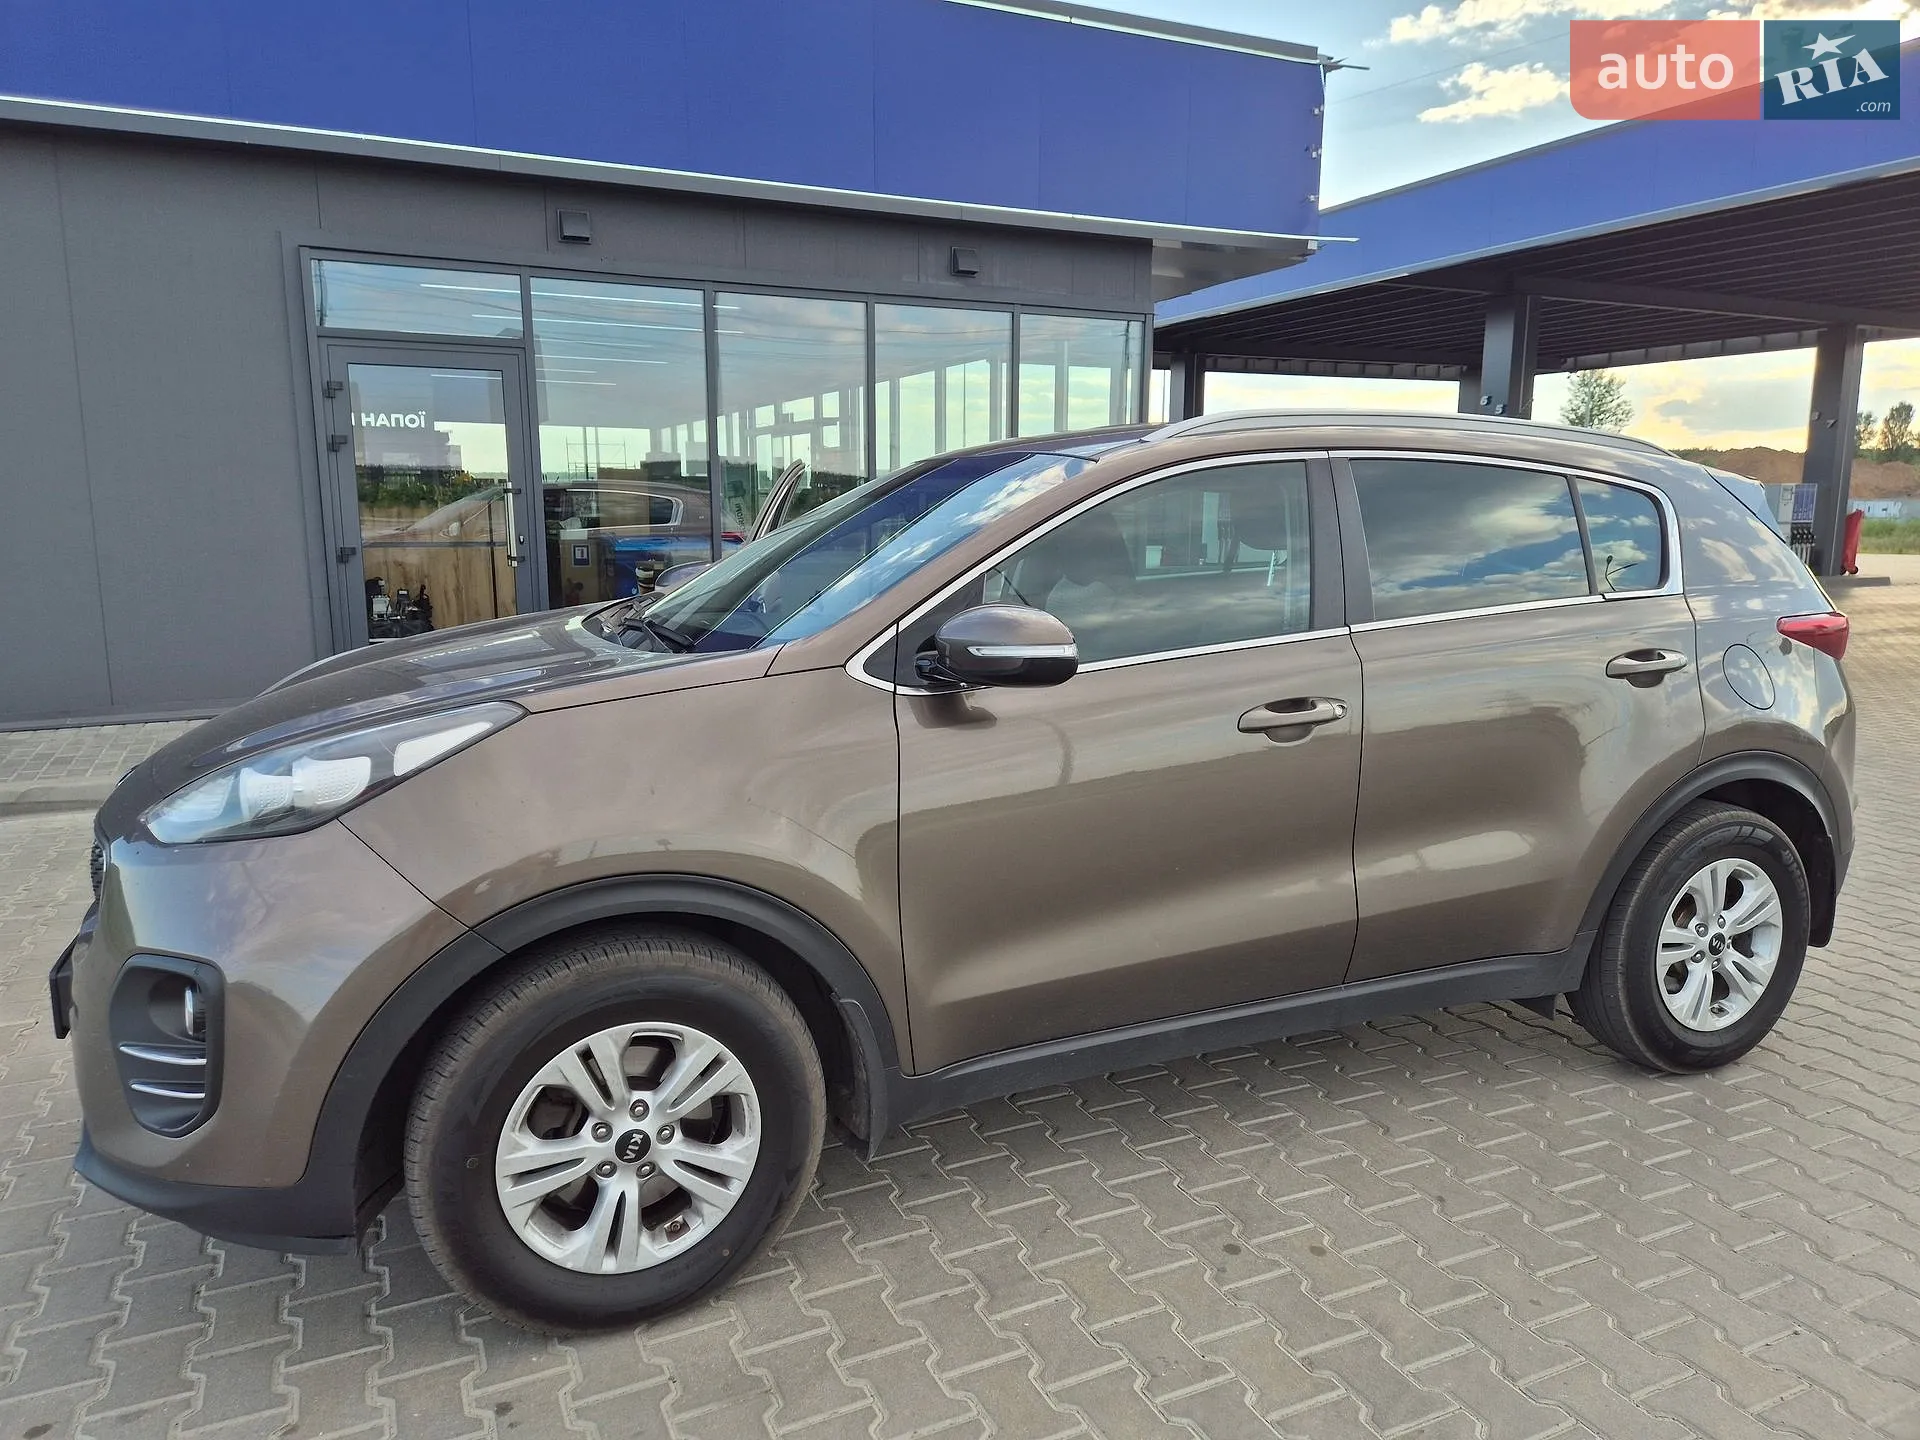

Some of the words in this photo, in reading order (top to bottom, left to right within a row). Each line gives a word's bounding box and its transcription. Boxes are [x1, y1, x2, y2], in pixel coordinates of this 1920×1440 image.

[1480, 395, 1489, 406] 6
[1495, 404, 1504, 415] 5
[360, 410, 426, 428] НАПОЇ
[623, 1133, 644, 1160] KIA
